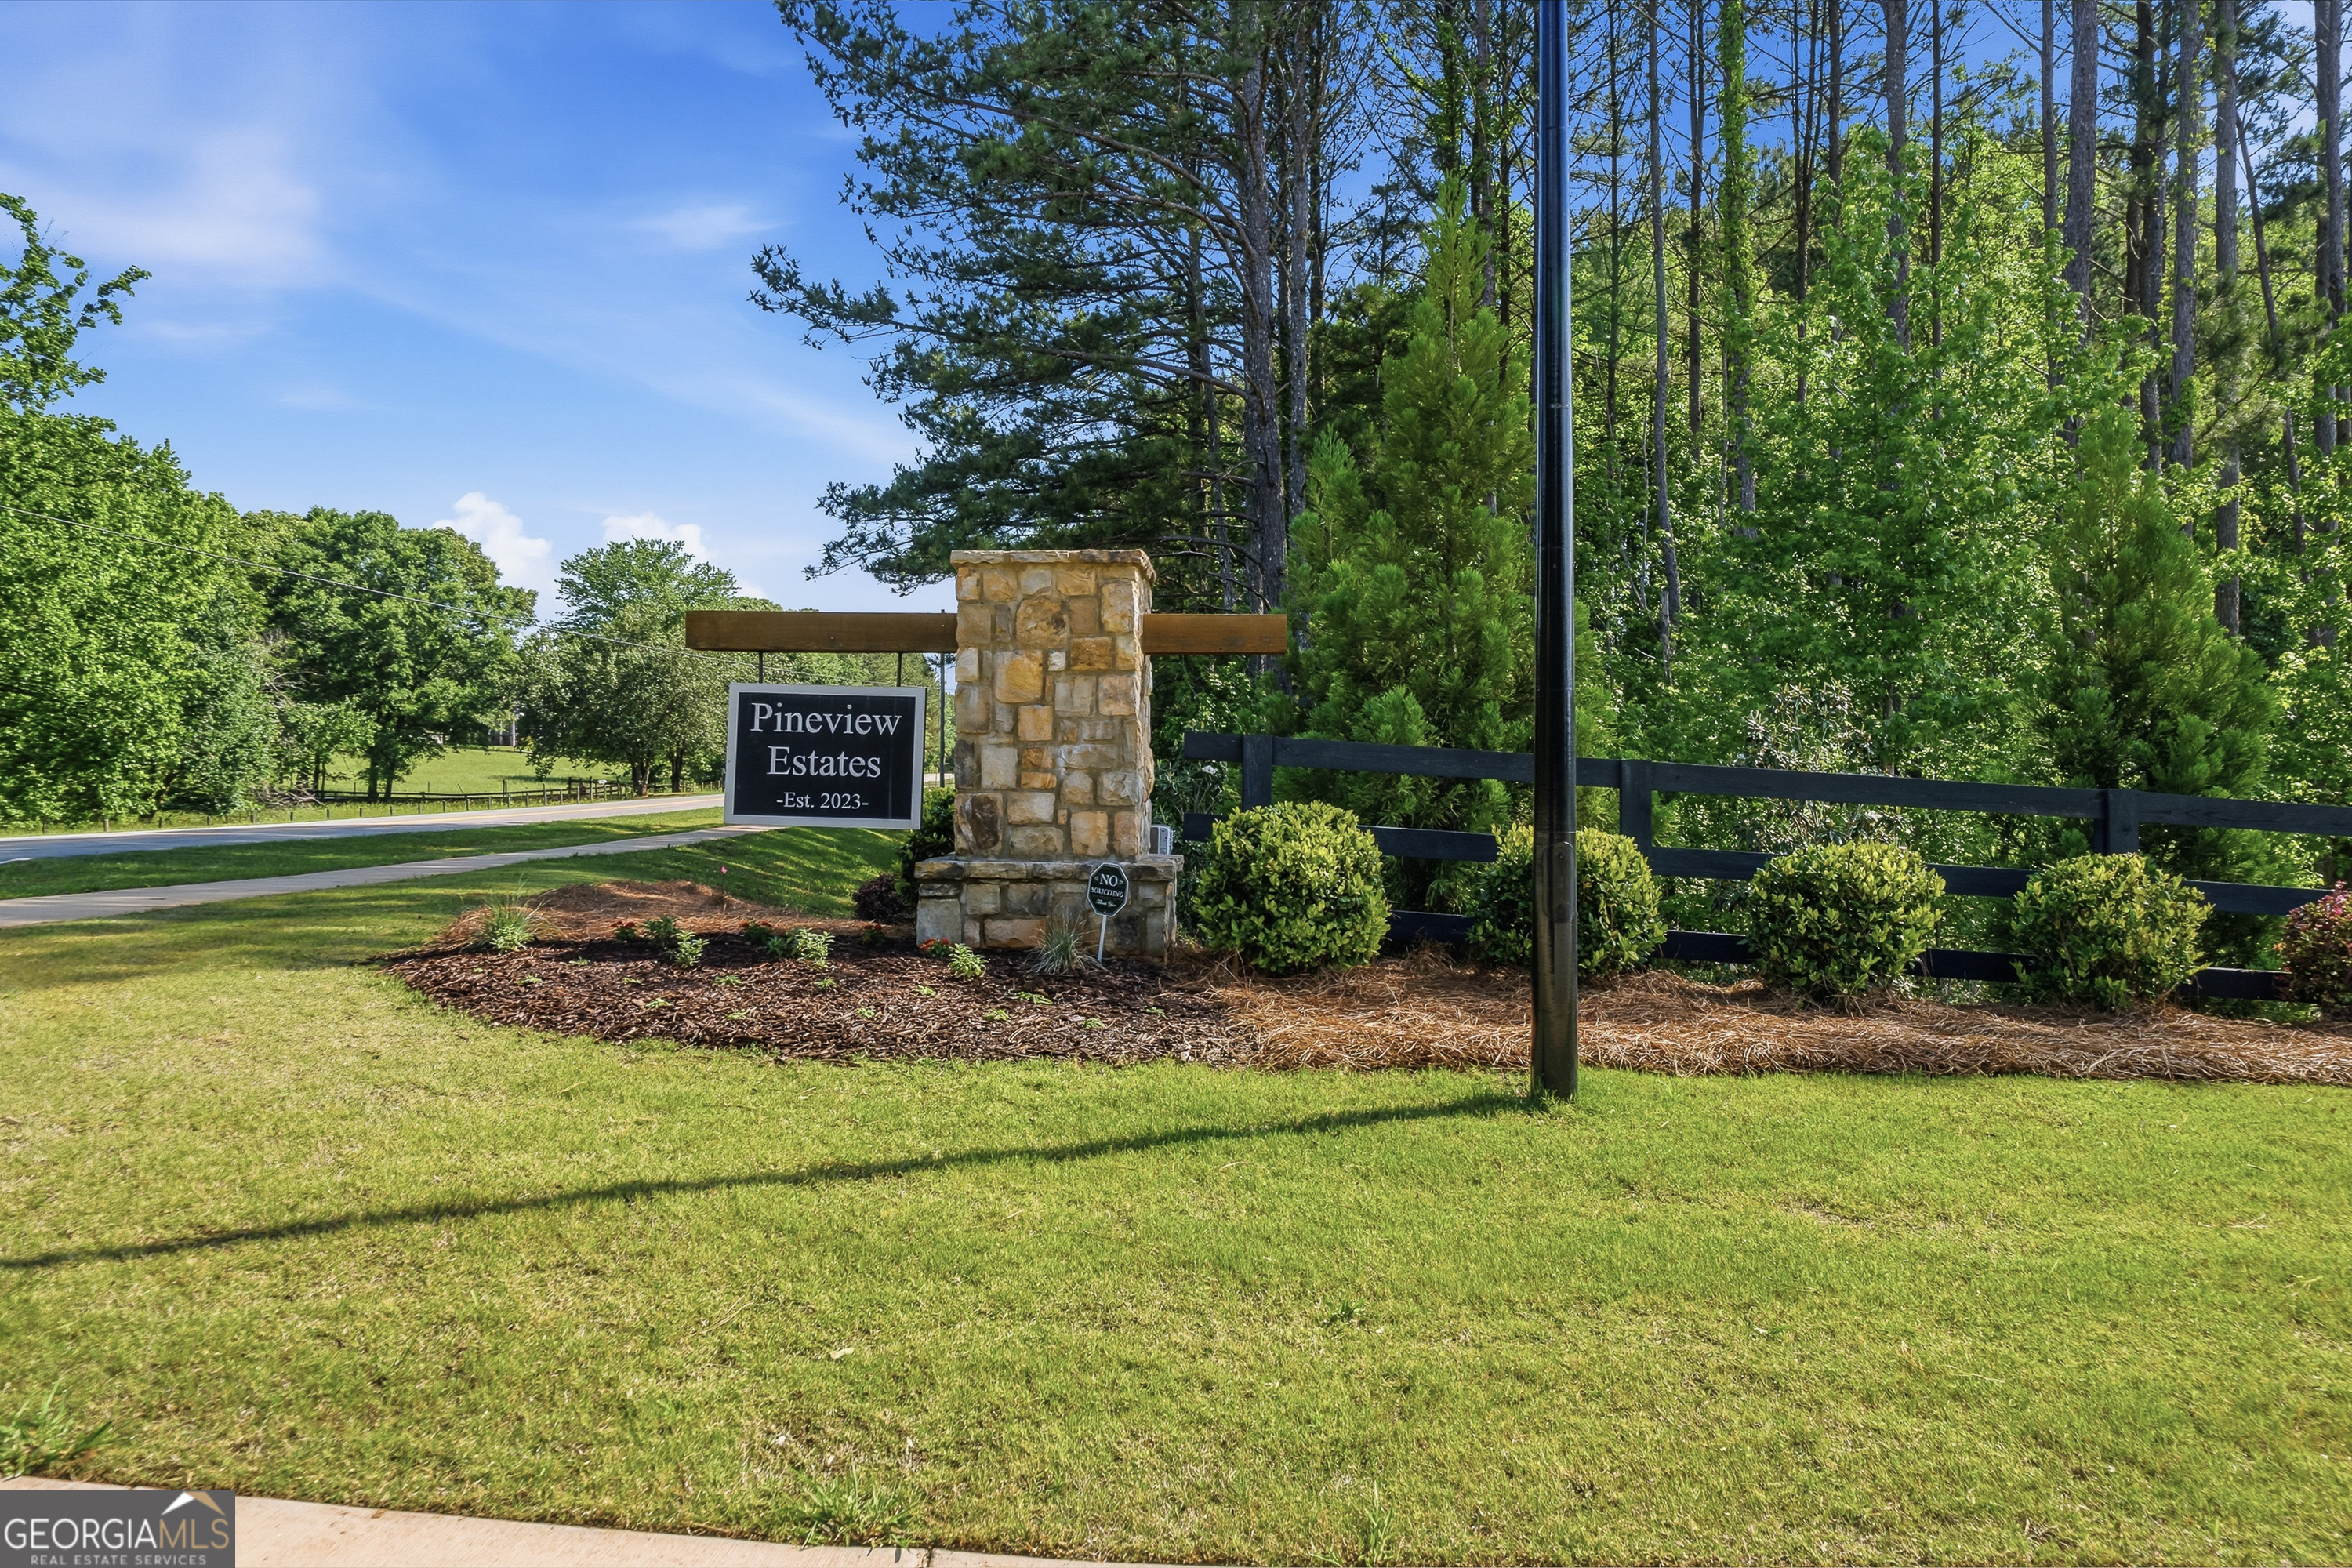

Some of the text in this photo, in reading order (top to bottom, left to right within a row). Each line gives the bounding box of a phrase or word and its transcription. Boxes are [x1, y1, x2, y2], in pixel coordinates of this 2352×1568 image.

[750, 702, 902, 735] Pineview
[767, 746, 881, 778] Estates
[776, 792, 869, 809] -Est. 2023-
[1099, 873, 1118, 887] NO
[1091, 887, 1123, 898] SOLICITING
